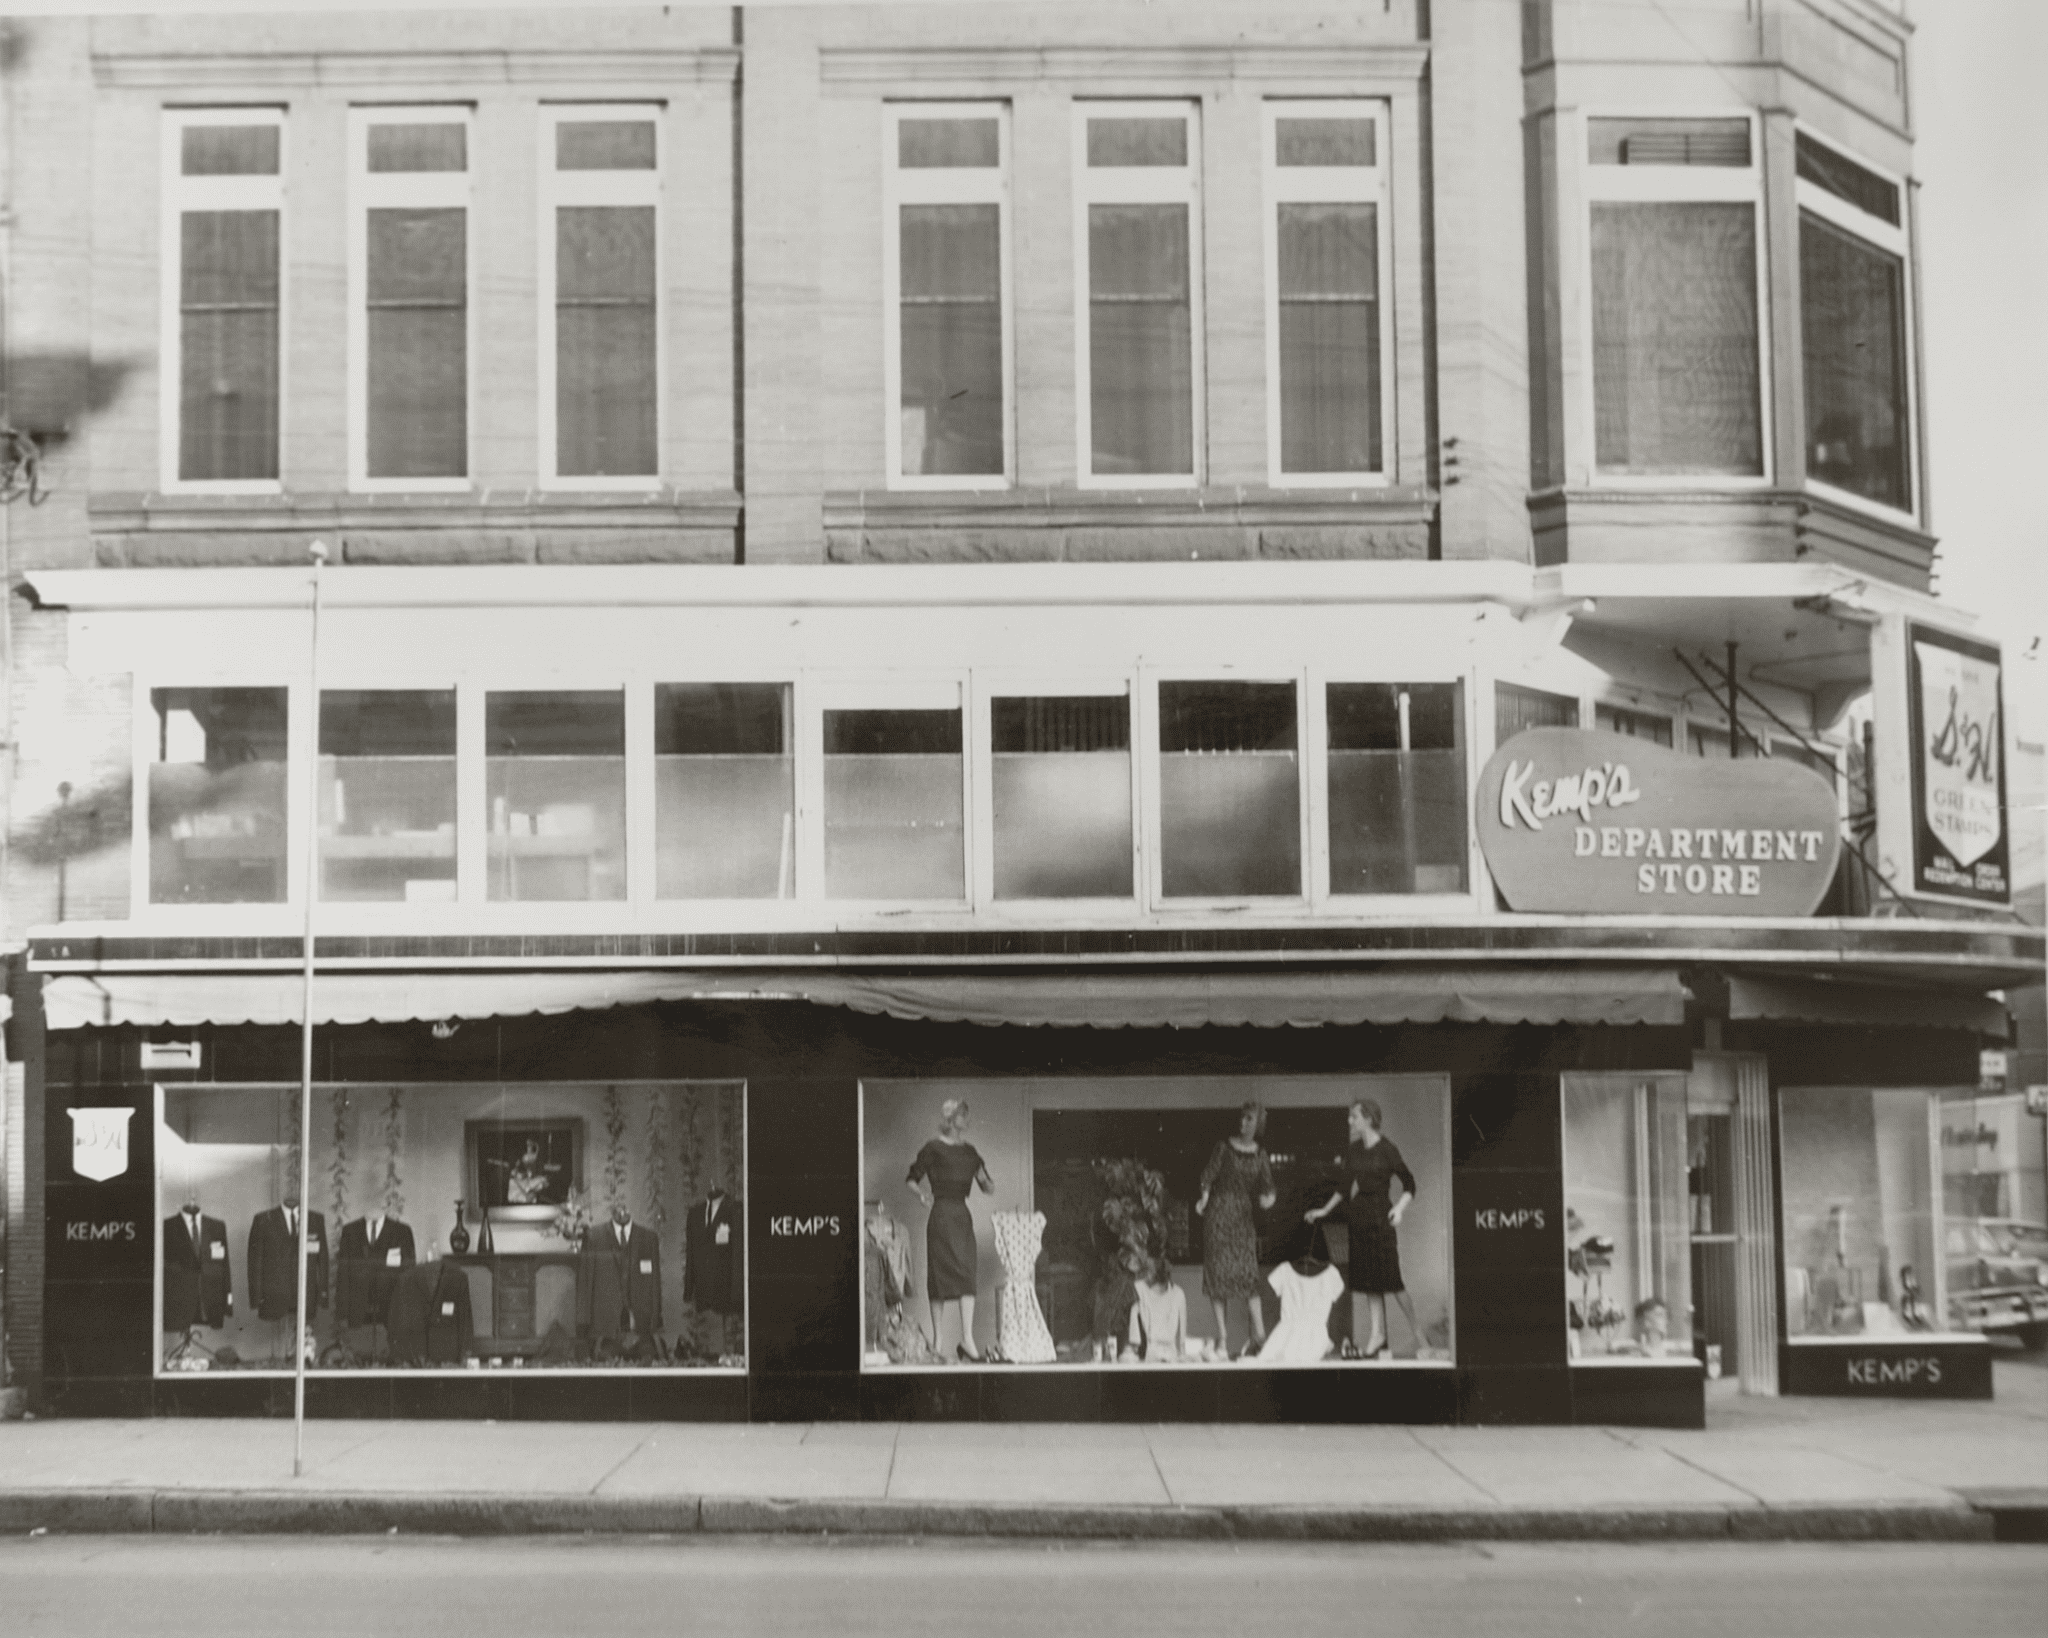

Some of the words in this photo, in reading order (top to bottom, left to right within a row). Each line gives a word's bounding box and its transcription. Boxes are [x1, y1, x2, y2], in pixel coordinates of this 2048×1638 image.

[1500, 760, 1641, 829] Kemp's
[1574, 826, 1824, 861] DEPARTMENT
[1638, 863, 1761, 896] STORE
[66, 1221, 136, 1241] KEMP'S
[770, 1215, 840, 1236] KEMP'S
[1475, 1208, 1545, 1230] KEMP'S
[1847, 1357, 1941, 1383] KEMP'S
